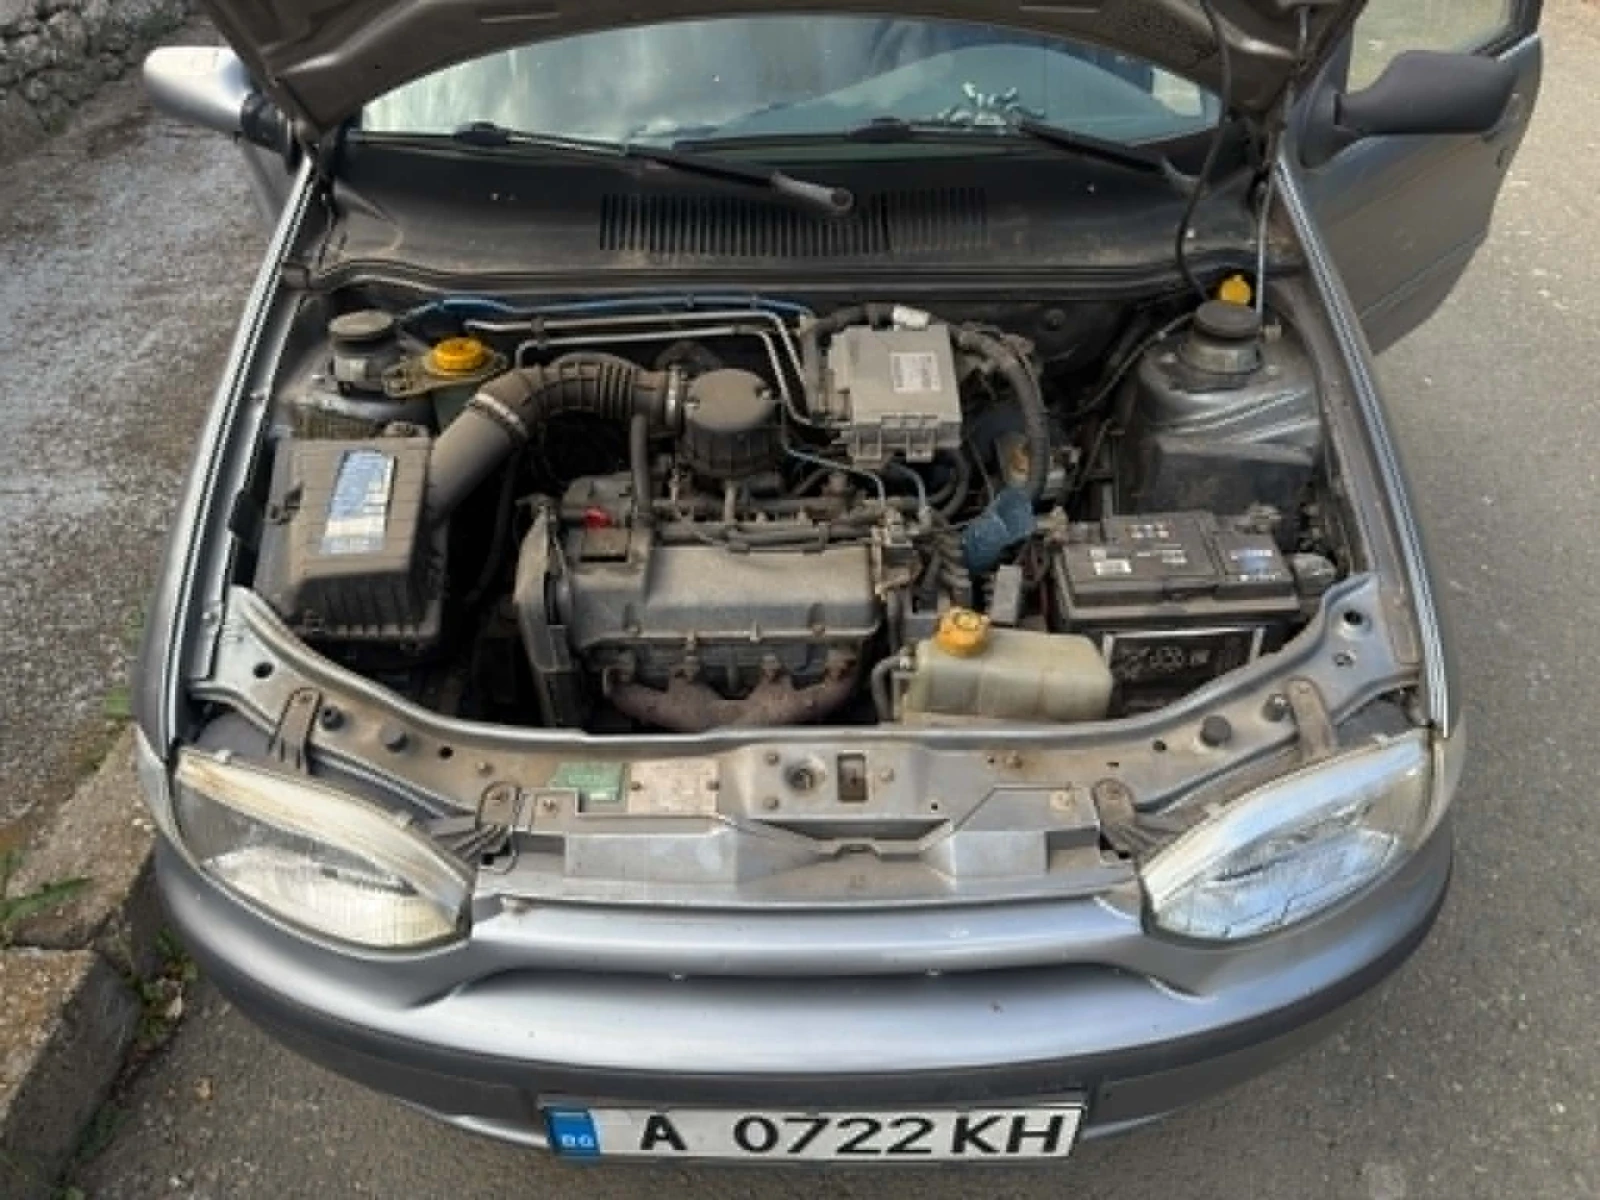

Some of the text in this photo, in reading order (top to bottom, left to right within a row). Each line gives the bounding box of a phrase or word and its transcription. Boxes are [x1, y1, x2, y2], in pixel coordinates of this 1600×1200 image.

[640, 1114, 1066, 1155] A 0722 KH
